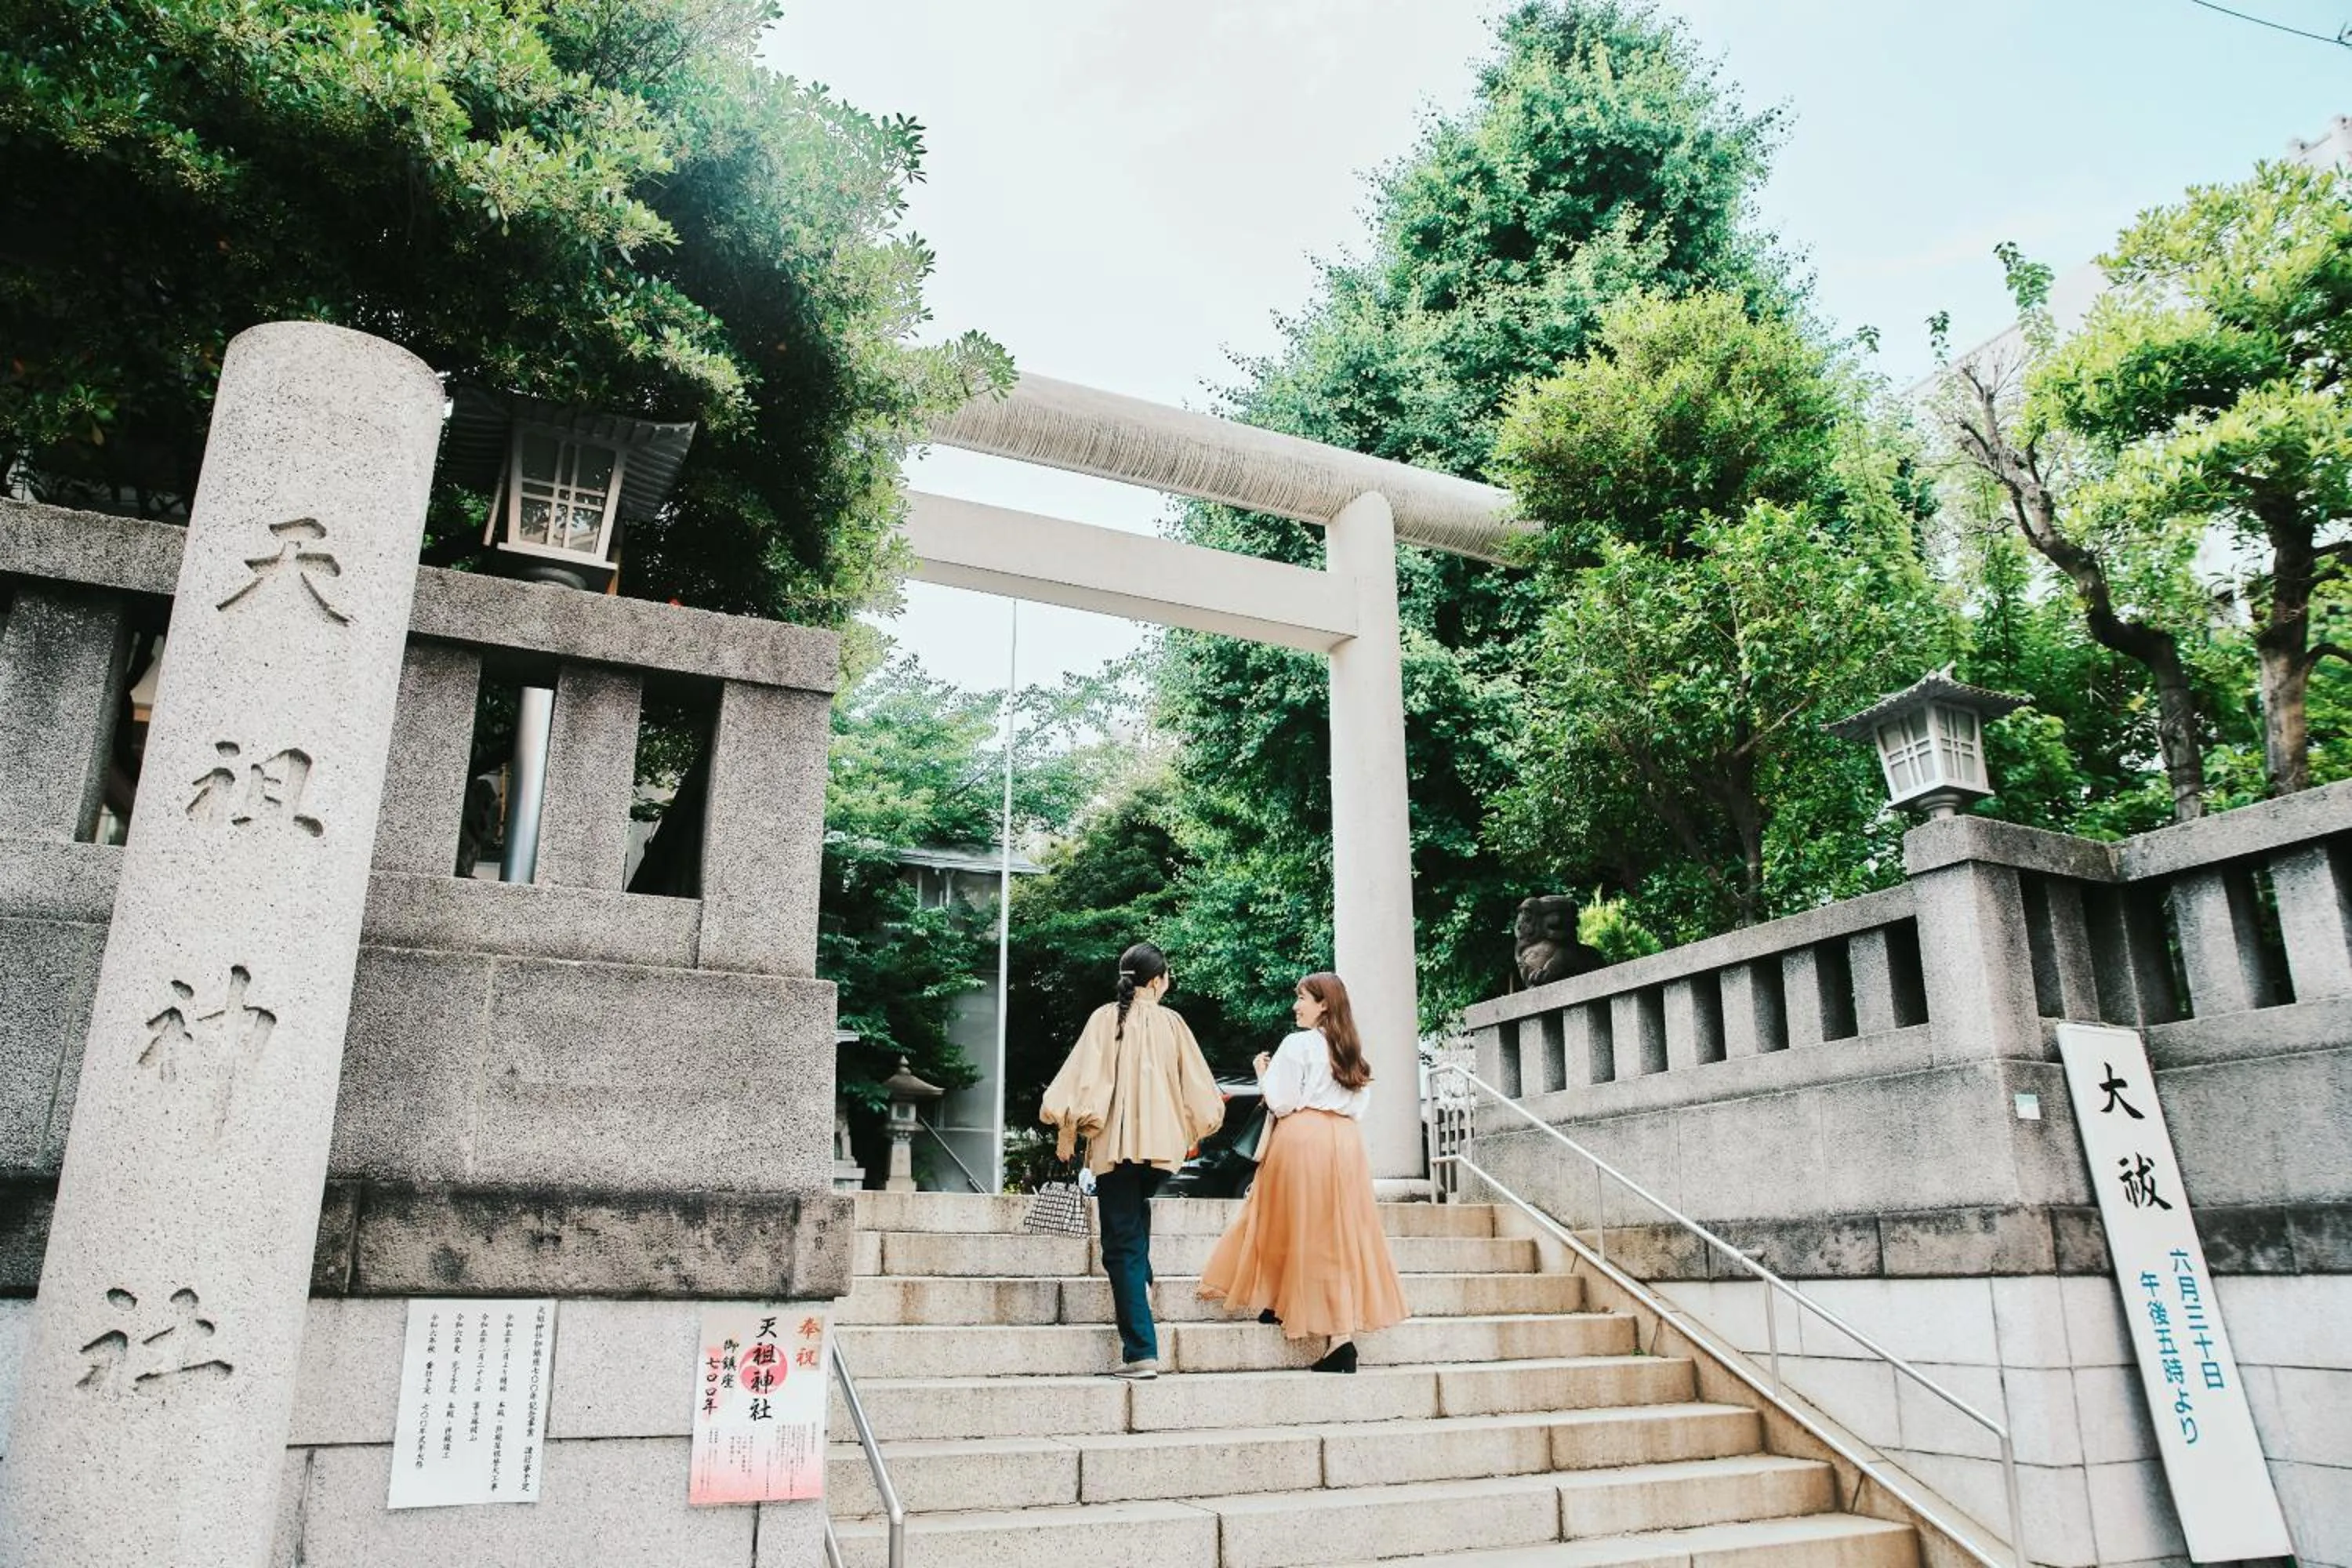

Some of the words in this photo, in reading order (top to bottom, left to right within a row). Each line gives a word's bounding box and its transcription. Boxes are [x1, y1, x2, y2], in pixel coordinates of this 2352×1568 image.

[76, 517, 351, 1391] 天祖神社
[2099, 1062, 2172, 1210] 大祓
[720, 1339, 739, 1388] 御鎮座
[750, 1316, 778, 1421] 天祖神社
[796, 1316, 821, 1367] 奉祝
[2140, 1271, 2198, 1443] 午後五時より
[2170, 1248, 2225, 1389] 六月三十日
